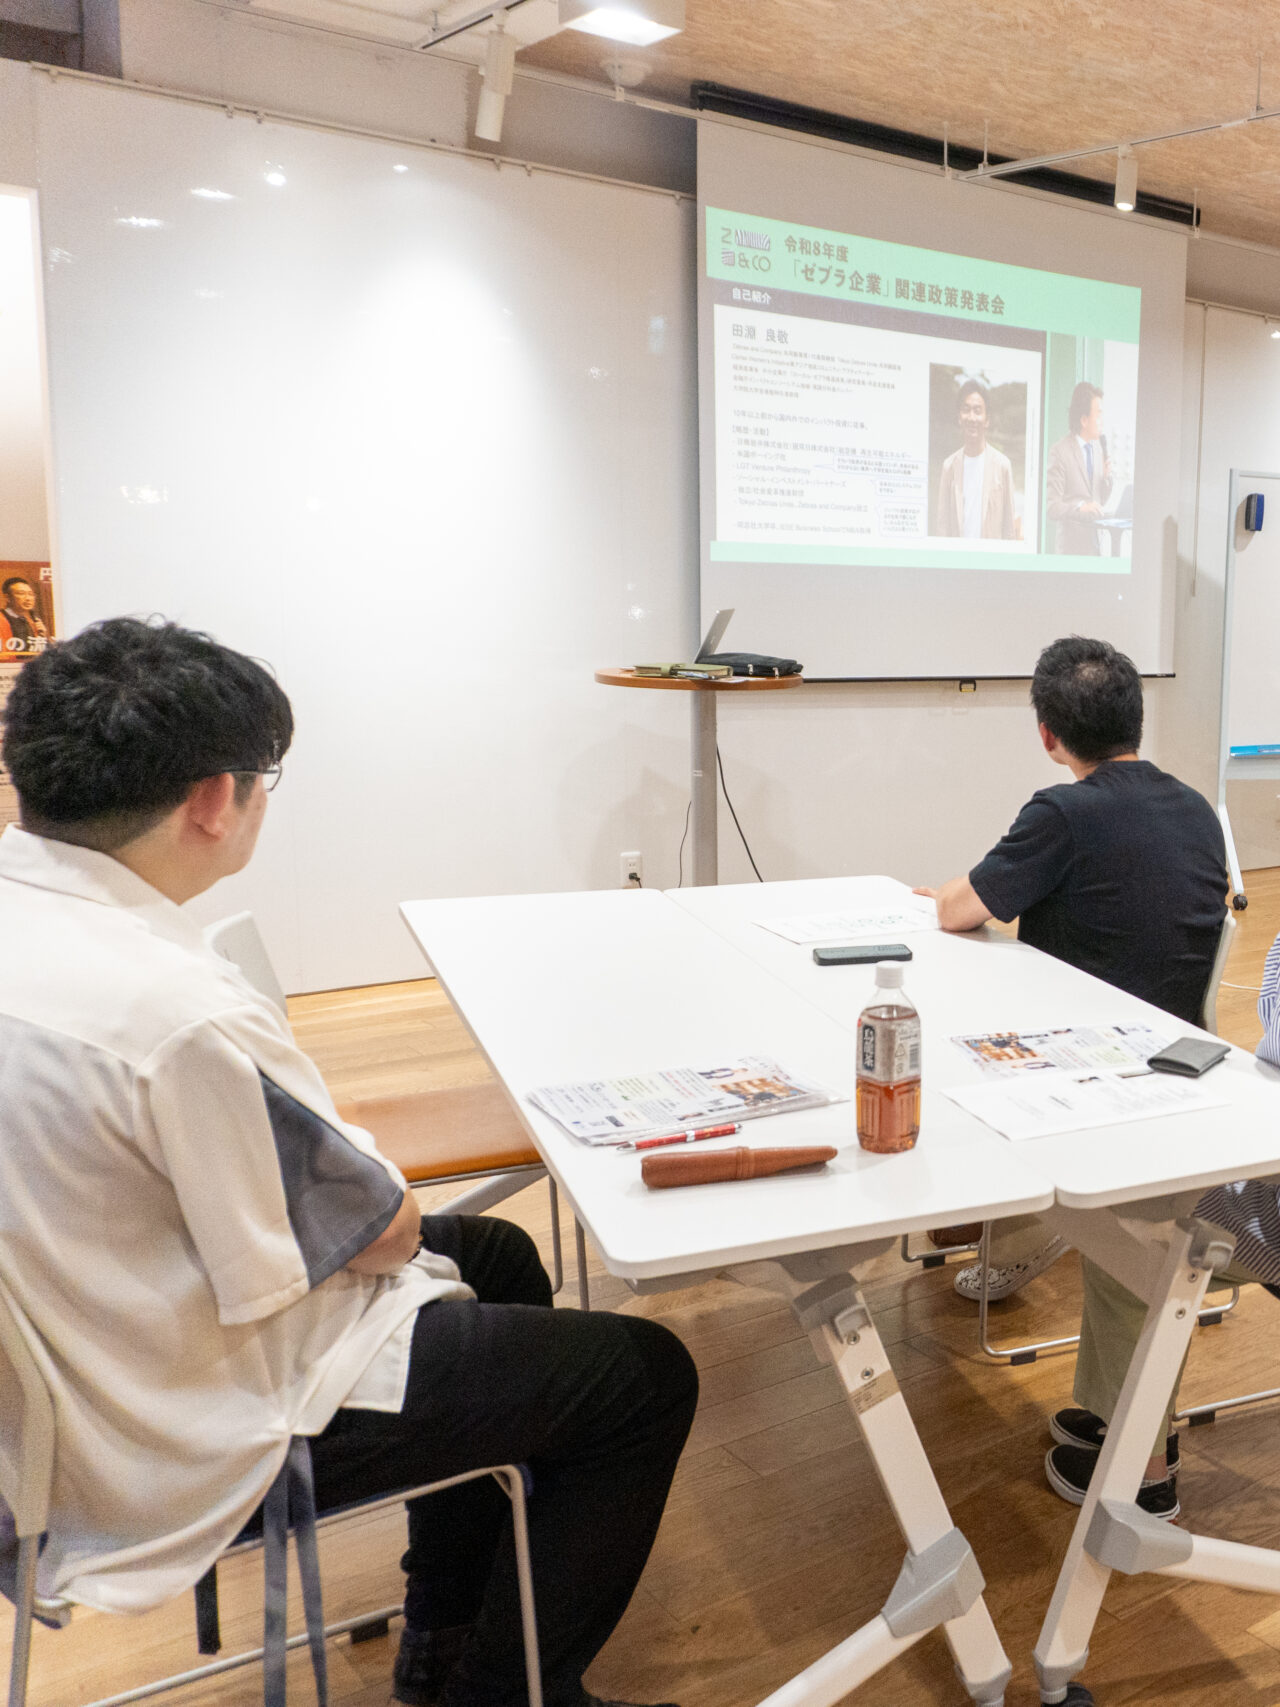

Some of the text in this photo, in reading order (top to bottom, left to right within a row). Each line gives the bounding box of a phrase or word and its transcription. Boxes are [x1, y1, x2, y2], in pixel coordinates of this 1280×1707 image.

[784, 234, 849, 264] 令和8年度
[731, 286, 772, 305] 自己紹介
[793, 258, 1006, 316] 「ゼブラ企業」関連政策発表会
